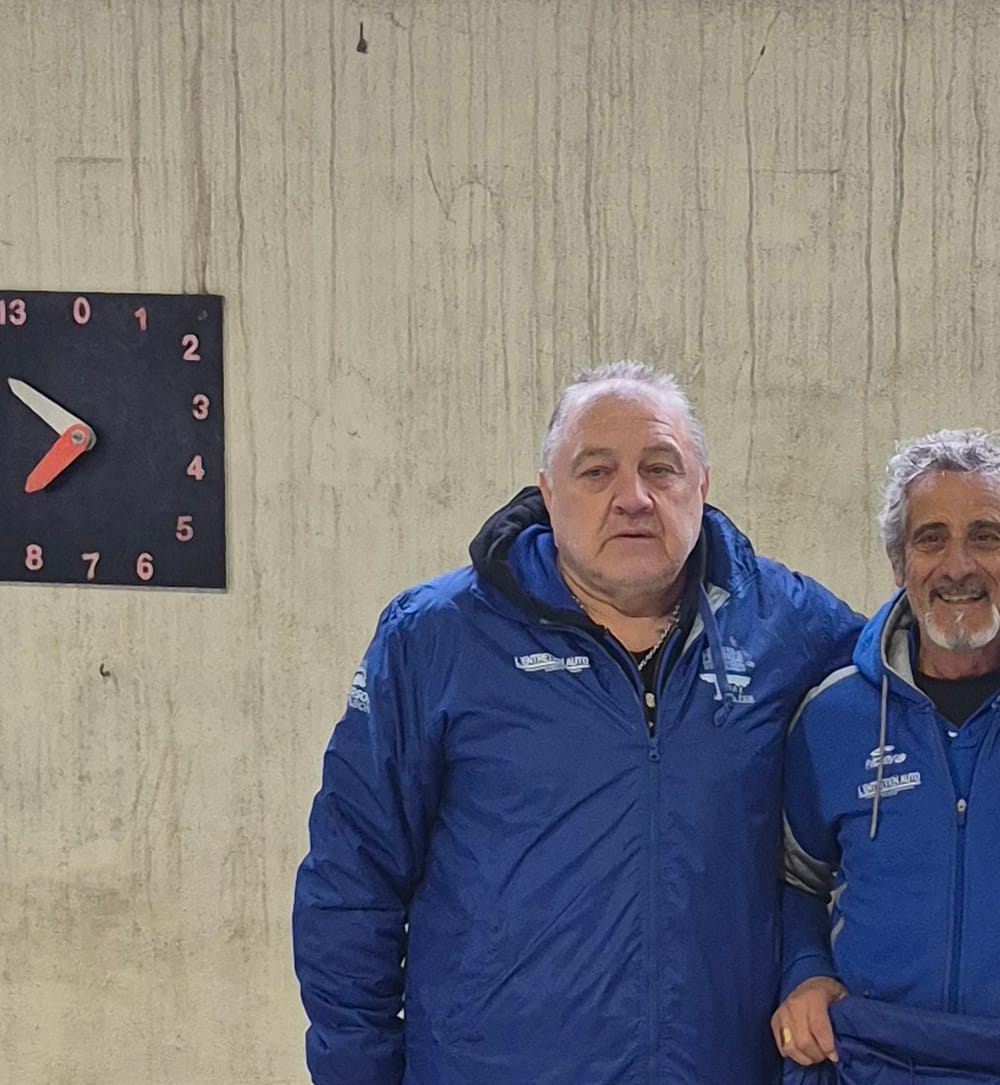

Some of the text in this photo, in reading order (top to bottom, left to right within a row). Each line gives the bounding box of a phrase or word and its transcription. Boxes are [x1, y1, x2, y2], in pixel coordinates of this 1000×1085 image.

[73, 297, 91, 325] 0
[134, 307, 148, 331] 1
[182, 334, 201, 361] 2
[192, 394, 210, 420] 3
[186, 455, 205, 480] 4
[176, 516, 194, 542] 5
[25, 544, 43, 571] 8
[81, 552, 100, 580] 7
[136, 553, 154, 580] 6
